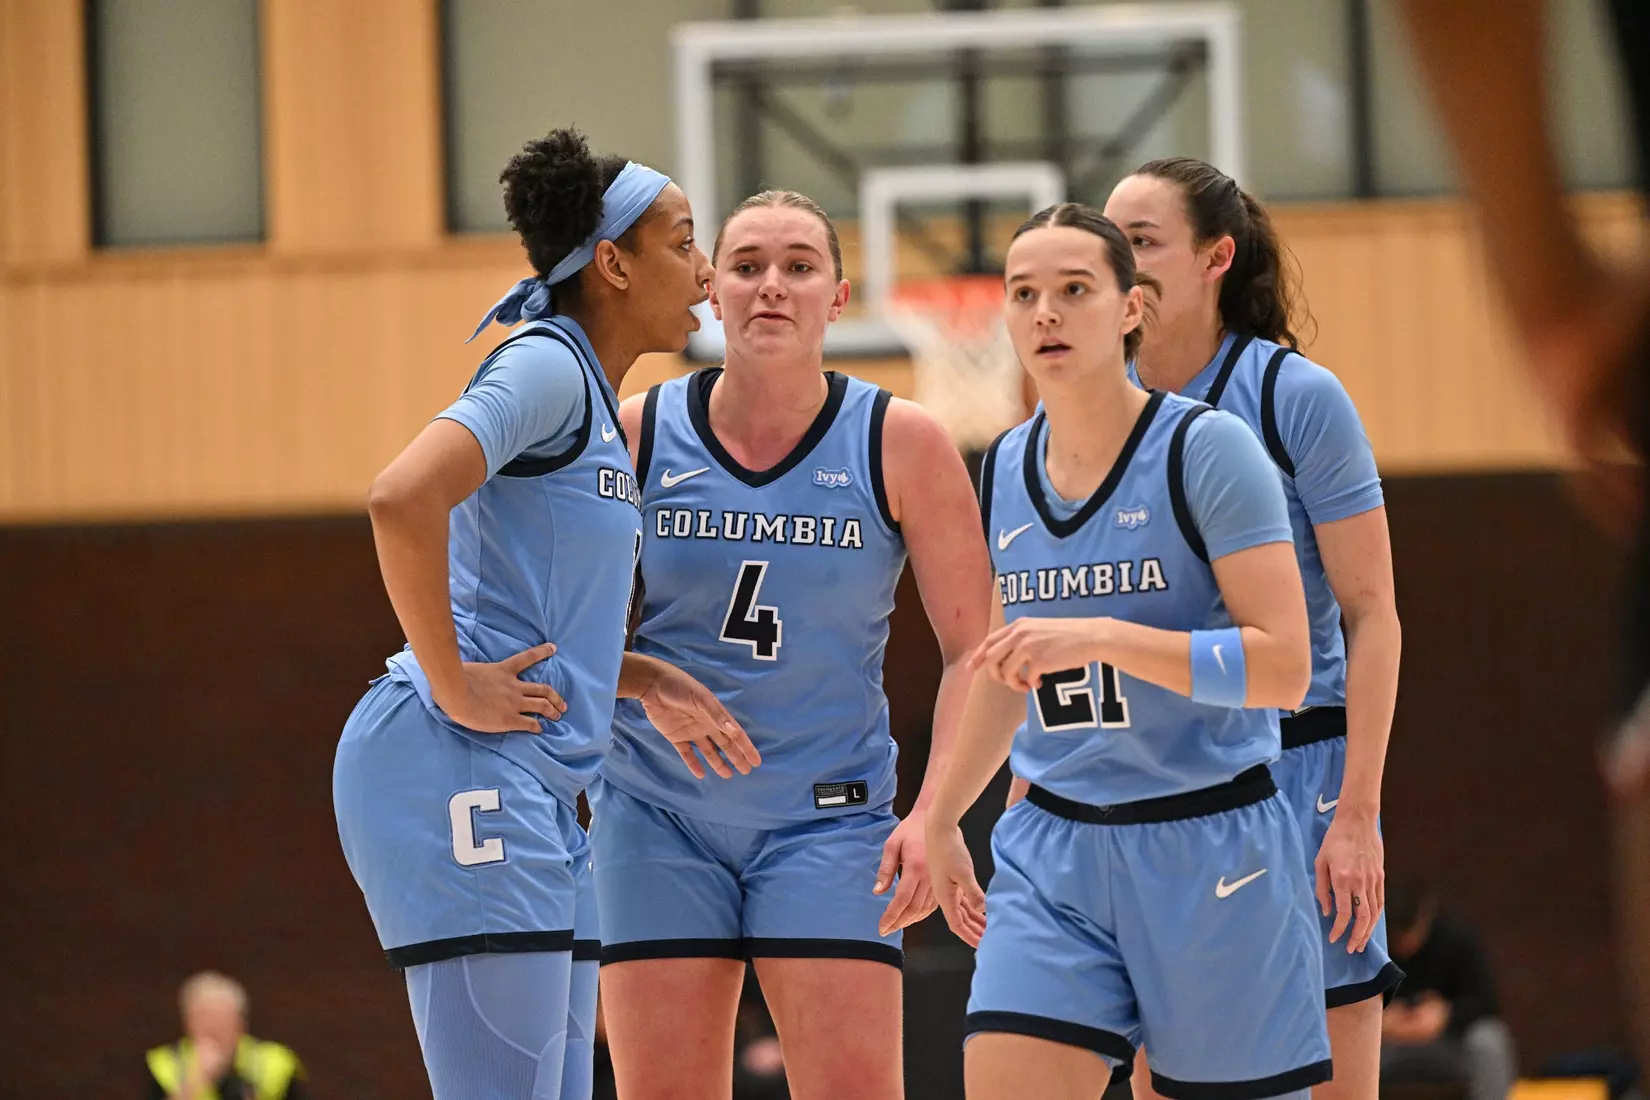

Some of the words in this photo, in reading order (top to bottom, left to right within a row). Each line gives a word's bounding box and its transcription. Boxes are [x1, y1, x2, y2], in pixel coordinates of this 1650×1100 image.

[656, 509, 863, 548] COLUMBIA
[718, 560, 782, 661] 4
[1032, 661, 1131, 732] 21
[448, 788, 506, 868] C
[853, 788, 860, 799] L
